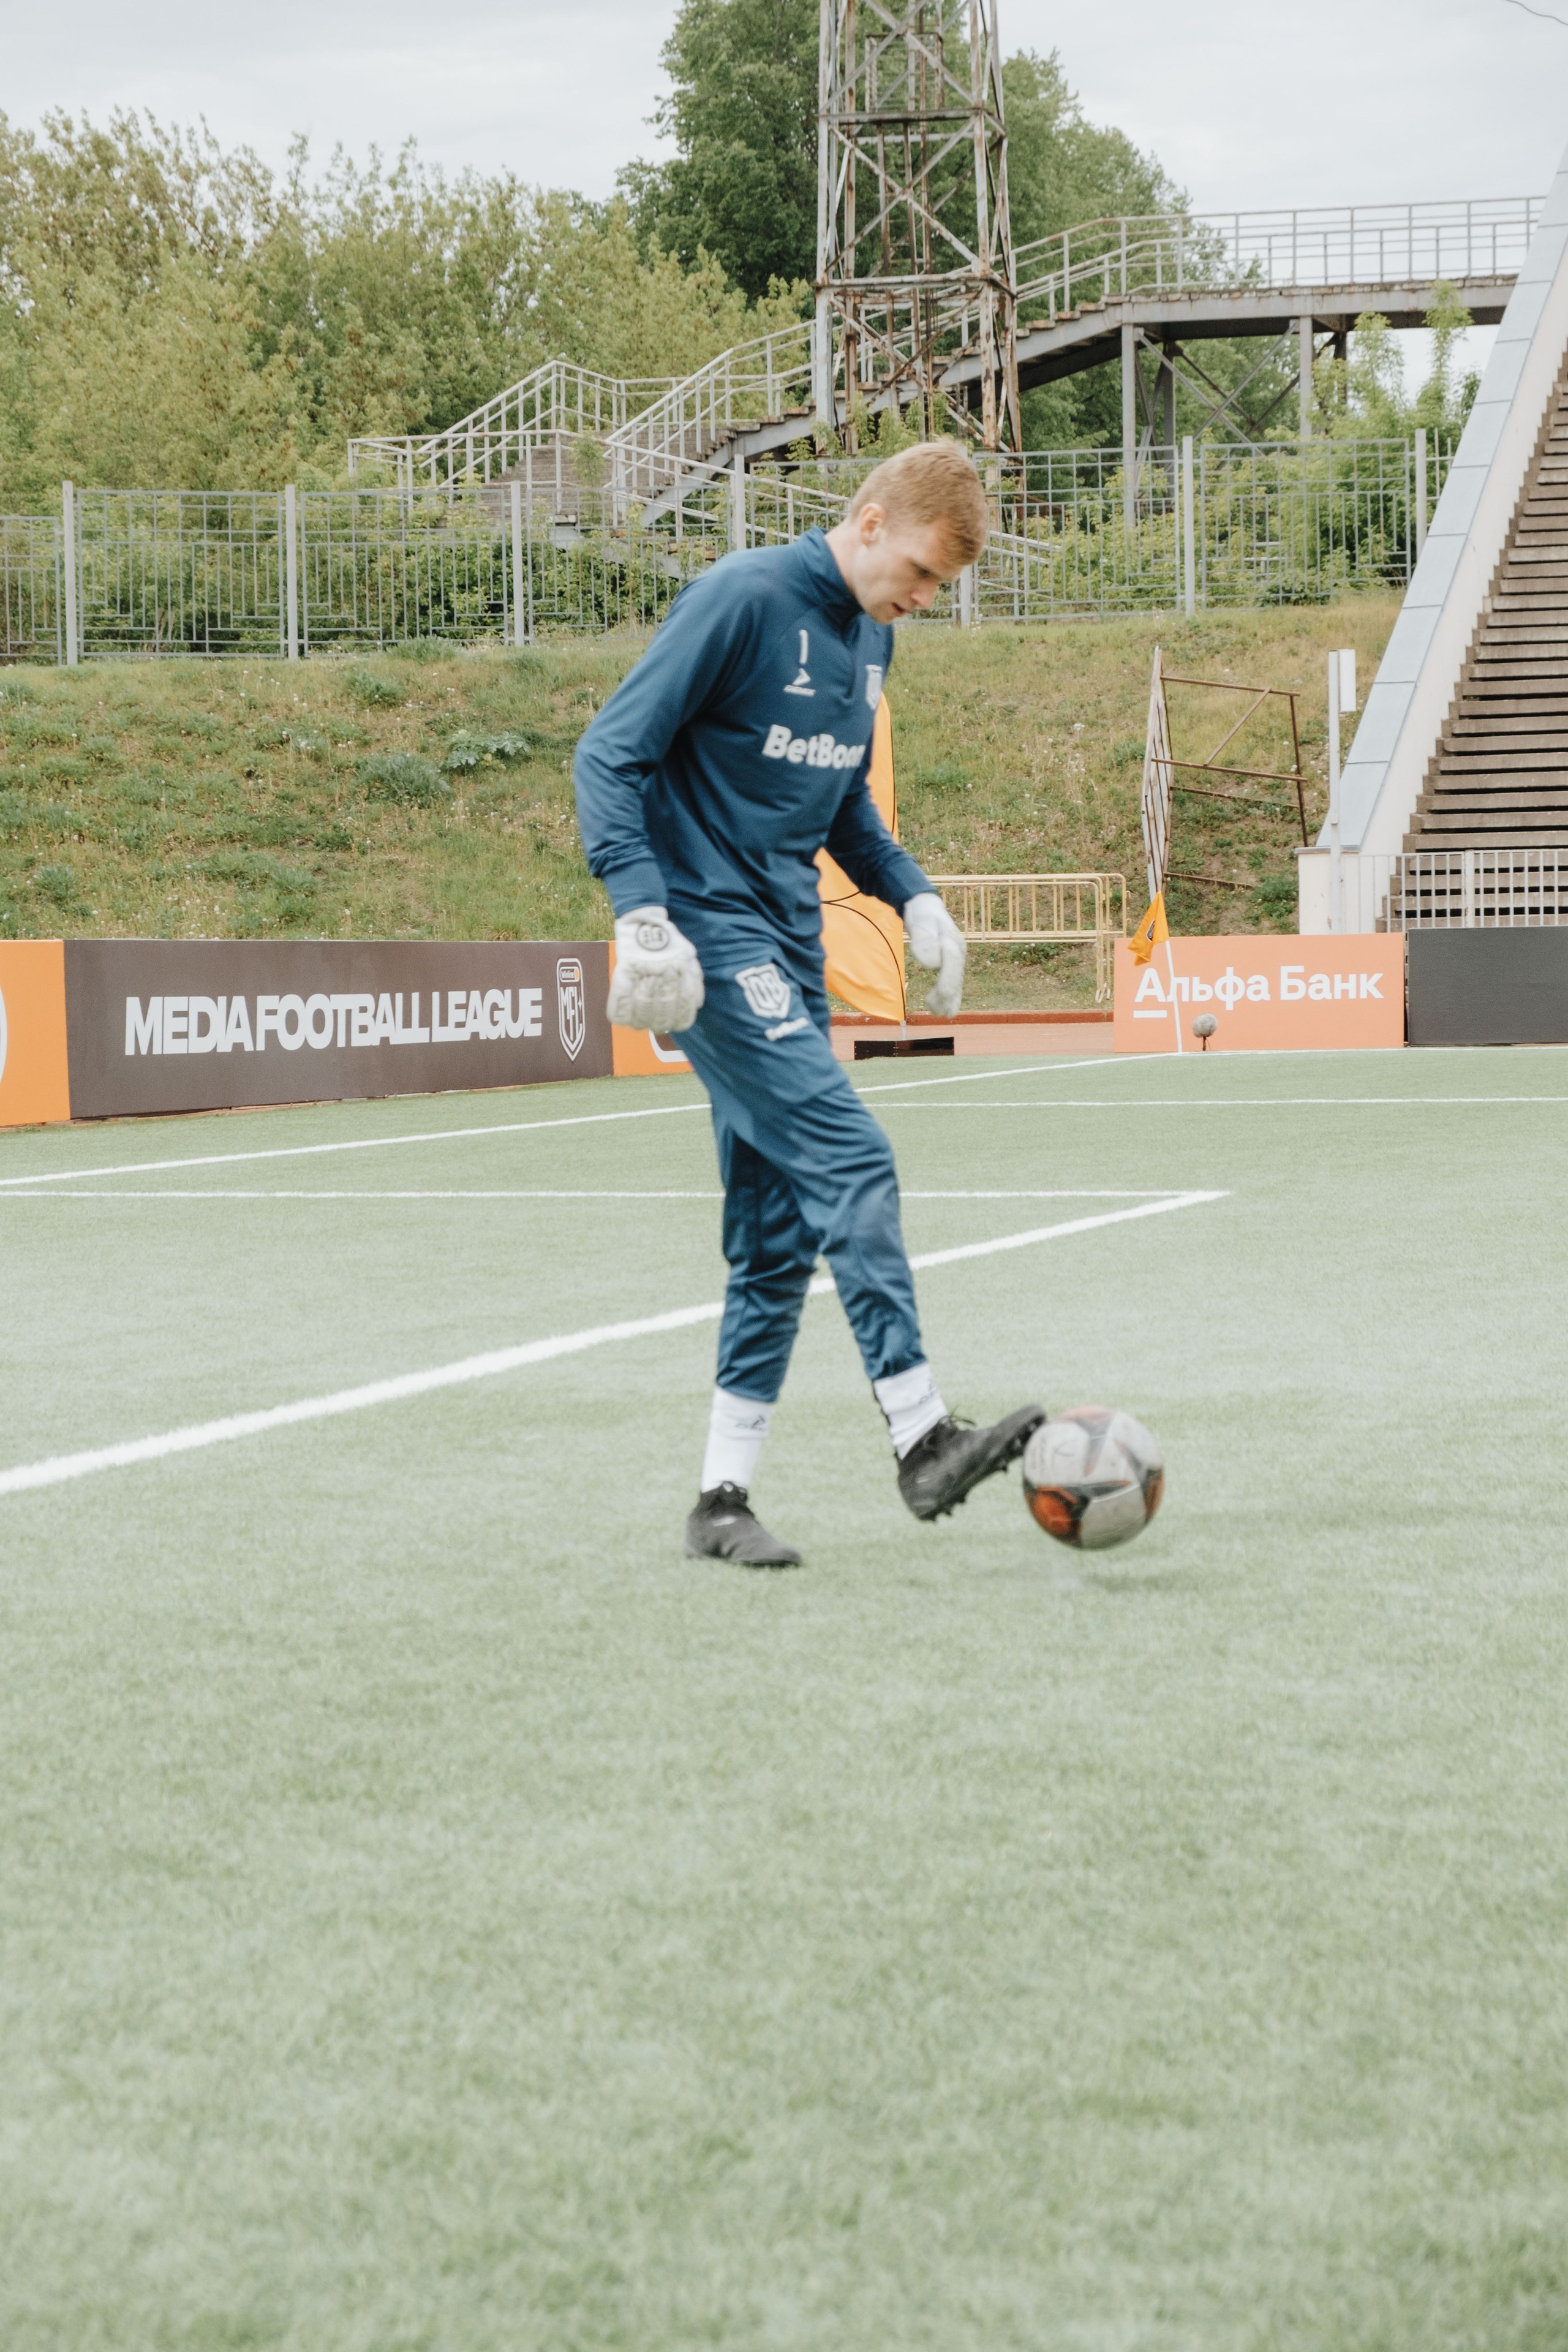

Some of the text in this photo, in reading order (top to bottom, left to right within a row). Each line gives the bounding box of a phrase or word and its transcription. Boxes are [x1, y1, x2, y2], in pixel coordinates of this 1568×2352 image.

[799, 629, 809, 665] 1
[1134, 965, 1384, 1011] Альфа Банк
[125, 987, 543, 1055] MEDIA FOOTBALL LEAGUE
